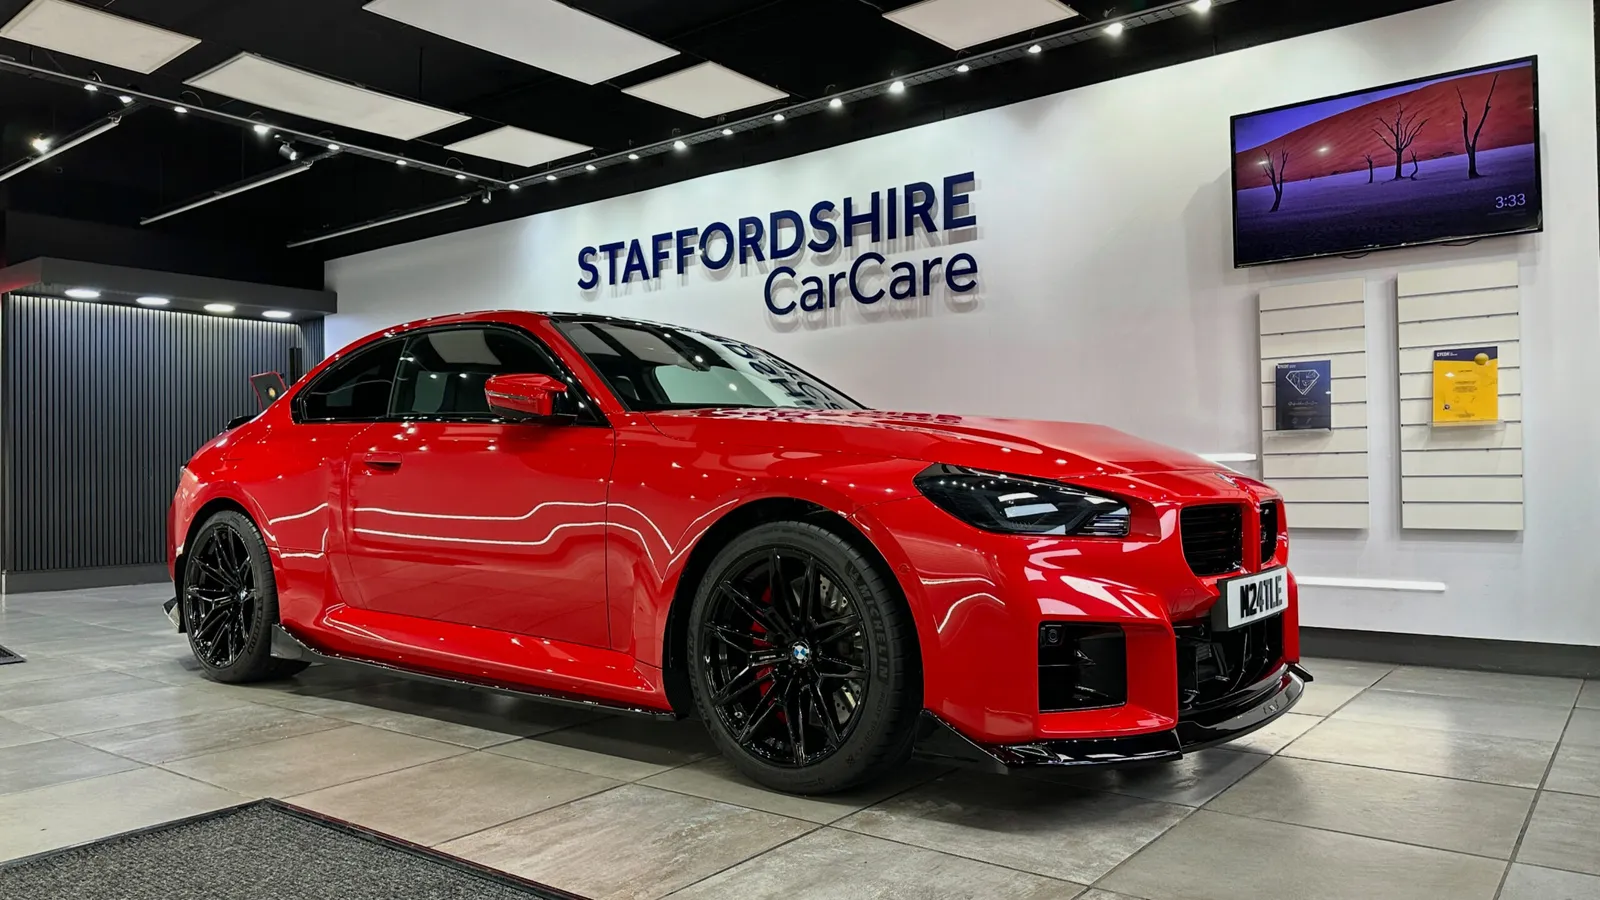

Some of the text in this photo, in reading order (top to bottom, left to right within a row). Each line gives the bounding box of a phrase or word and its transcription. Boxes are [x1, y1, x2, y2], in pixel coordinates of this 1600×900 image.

[577, 171, 977, 290] STAFFORDSHIRE
[1495, 193, 1526, 209] 3:33
[764, 252, 978, 315] CarCare
[857, 583, 889, 682] MICHELIN
